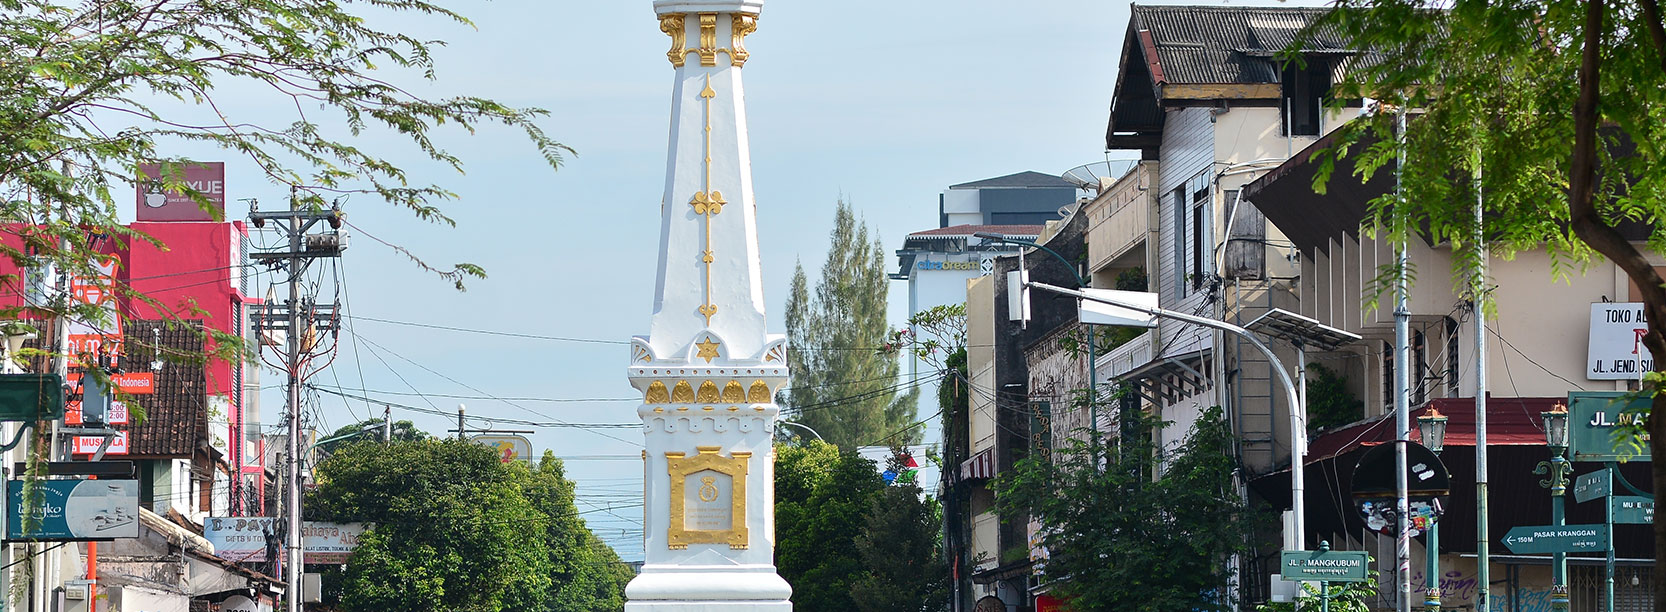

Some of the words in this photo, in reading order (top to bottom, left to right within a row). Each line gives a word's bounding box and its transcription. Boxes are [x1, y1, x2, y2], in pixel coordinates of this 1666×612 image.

[168, 181, 222, 194] XUE
[1606, 309, 1631, 323] TOKO
[1636, 309, 1648, 323] AL
[1593, 360, 1608, 373] JL.
[1611, 360, 1637, 373] JEND.
[1641, 360, 1656, 373] SU
[120, 378, 150, 387] Indonesia
[1591, 412, 1615, 426] JL.
[1618, 412, 1651, 426] MA
[82, 438, 123, 446] MUSLA
[303, 524, 339, 540] ahaya
[1307, 559, 1360, 567] MANGKUBUMI
